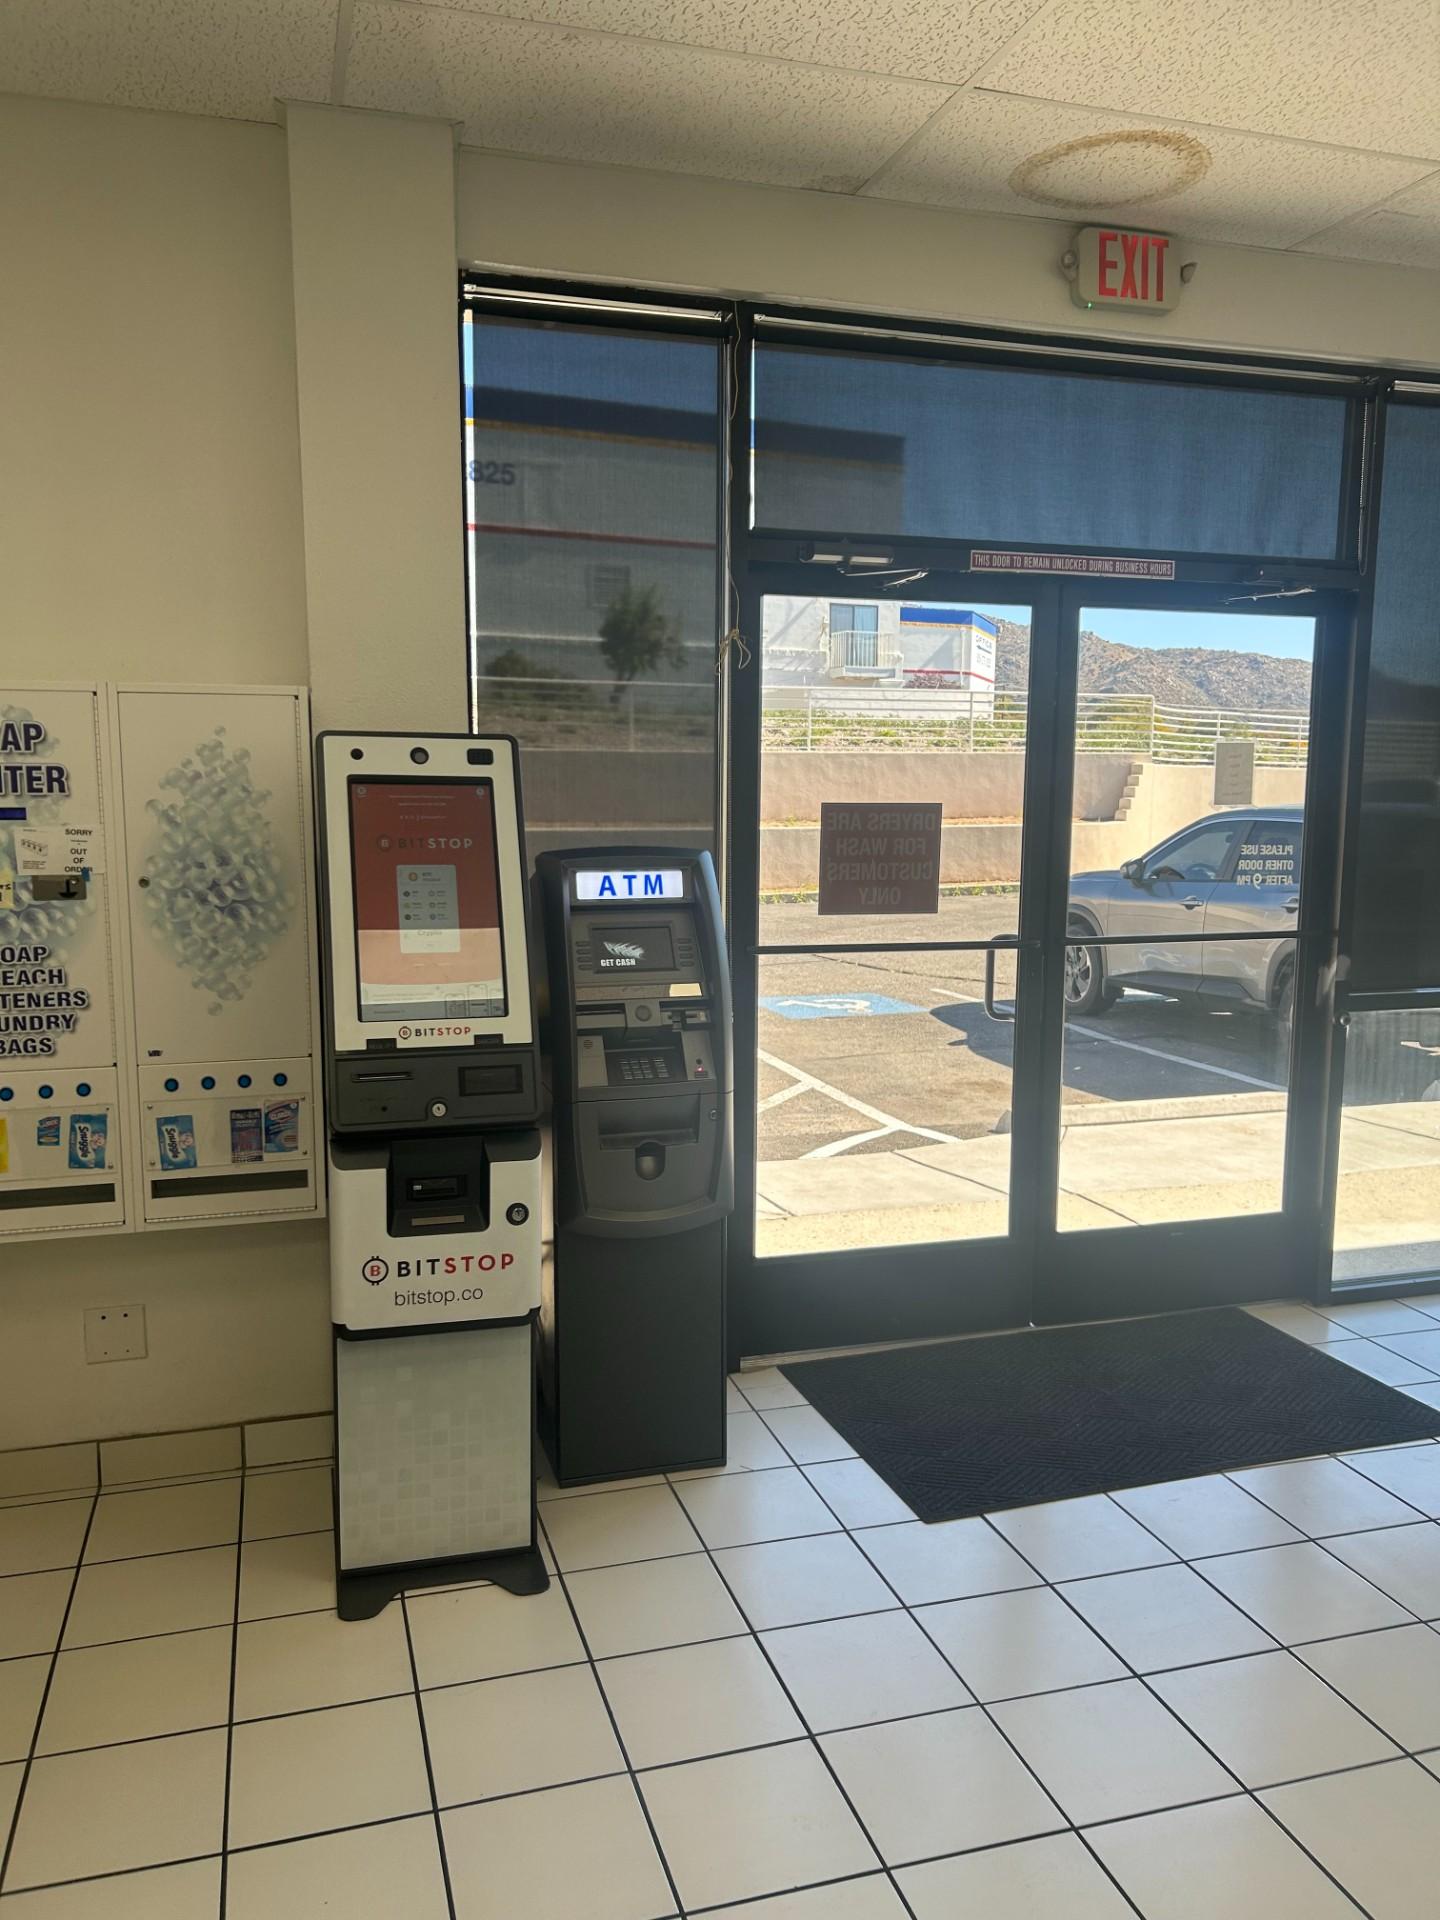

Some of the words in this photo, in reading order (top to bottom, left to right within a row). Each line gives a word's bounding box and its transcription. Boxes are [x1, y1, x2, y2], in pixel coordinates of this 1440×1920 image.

[1098, 231, 1169, 302] EXIT
[469, 460, 515, 486] 825
[974, 554, 990, 567] THIS
[992, 555, 1011, 568] DOOR
[1013, 556, 1022, 568] TO
[1024, 556, 1050, 569] REMAIN
[1052, 558, 1087, 571] UNLOCKED
[1089, 560, 1113, 572] DURING
[1115, 562, 1148, 574] BUSINESS
[1150, 563, 1172, 575] HOURS
[65, 828, 93, 836] SORRY
[599, 874, 664, 896] ATM
[600, 959, 614, 967] GET
[615, 958, 636, 967] CASH
[415, 1026, 471, 1037] BITSTOP
[397, 1253, 514, 1278] BITSTOP
[394, 1287, 483, 1306] bitstop.co
